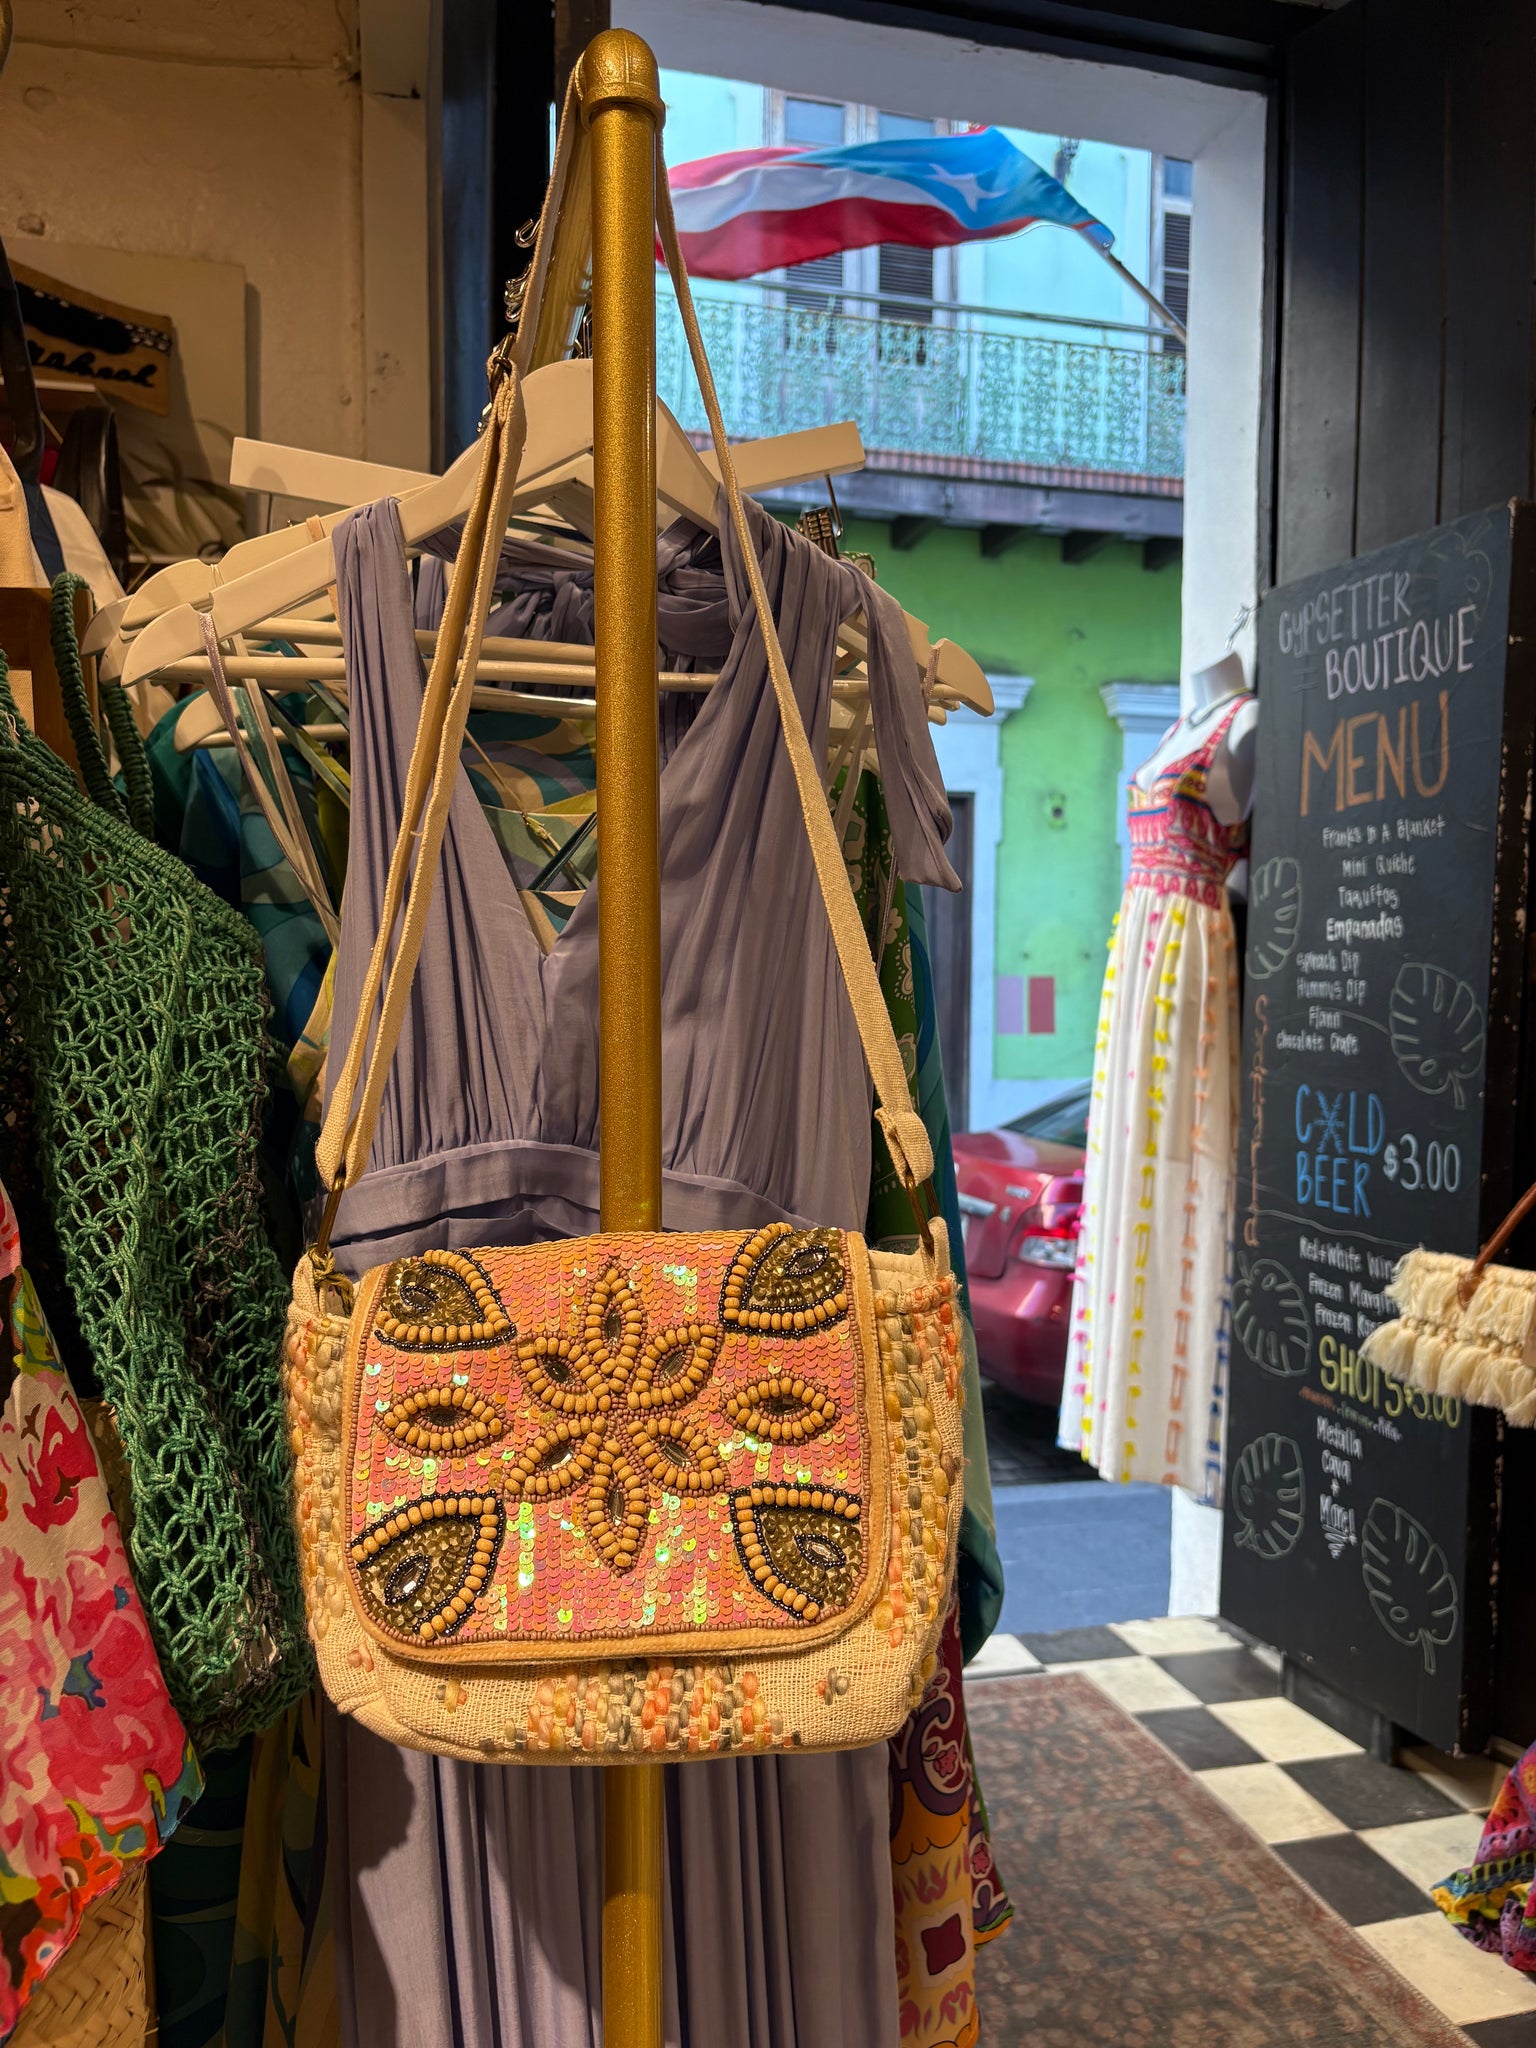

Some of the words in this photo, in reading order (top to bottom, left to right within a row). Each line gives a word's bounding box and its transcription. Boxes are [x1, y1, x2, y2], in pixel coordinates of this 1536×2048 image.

[1325, 603, 1477, 700] BOUTIQUE
[1300, 690, 1449, 816] MENU
[1326, 911, 1403, 943] Empanadas
[1296, 1150, 1372, 1219] BEER
[1383, 1133, 1462, 1193] $3.00
[1321, 1449, 1352, 1486] Cava
